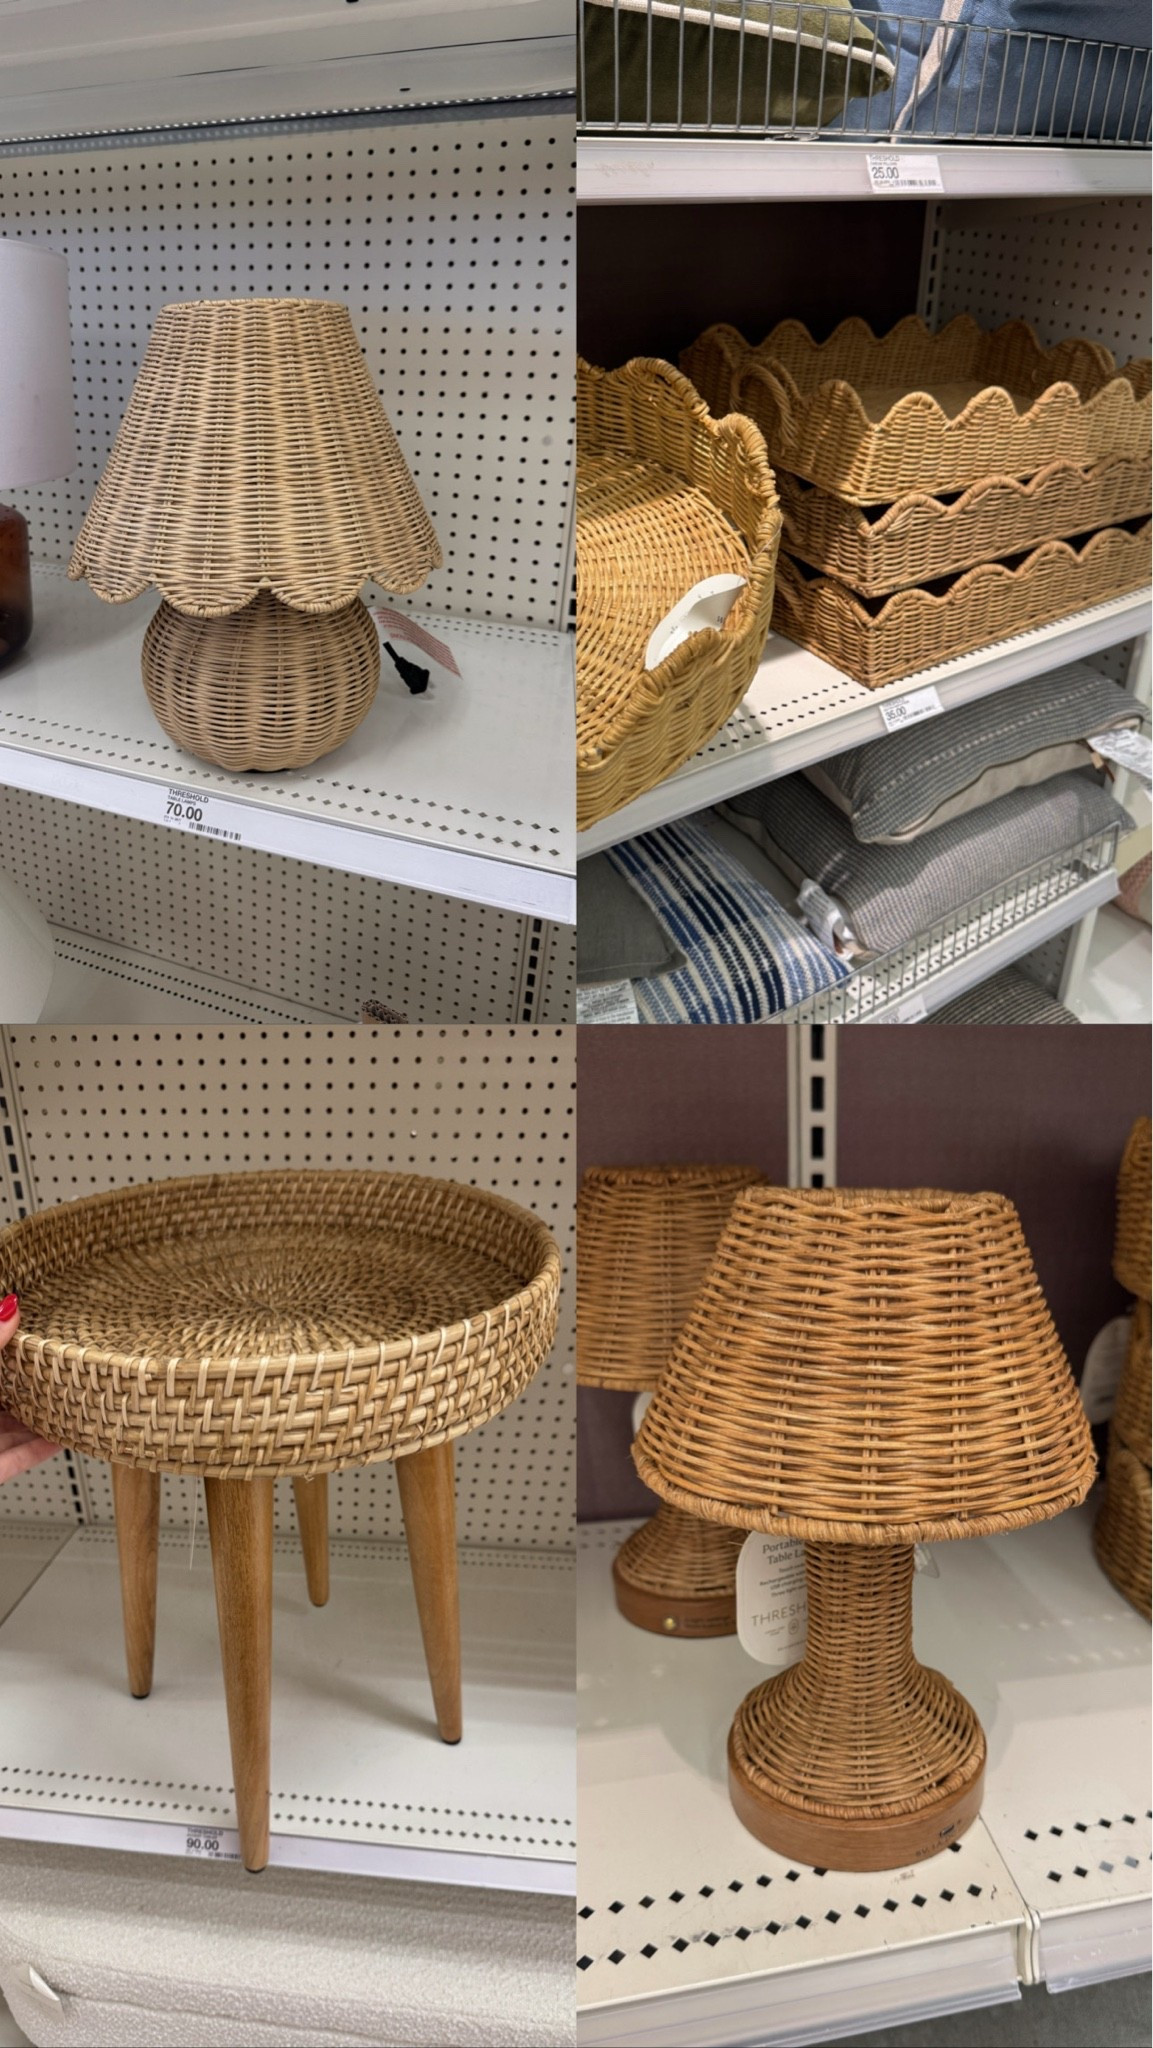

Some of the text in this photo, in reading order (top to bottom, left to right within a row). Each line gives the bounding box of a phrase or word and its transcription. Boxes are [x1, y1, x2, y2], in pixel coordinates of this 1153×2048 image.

[871, 167, 900, 179] 25.00
[169, 788, 209, 804] THRESHOLD
[166, 801, 203, 822] 70.00
[767, 1551, 793, 1565] Table
[186, 1838, 220, 1851] 90.00
